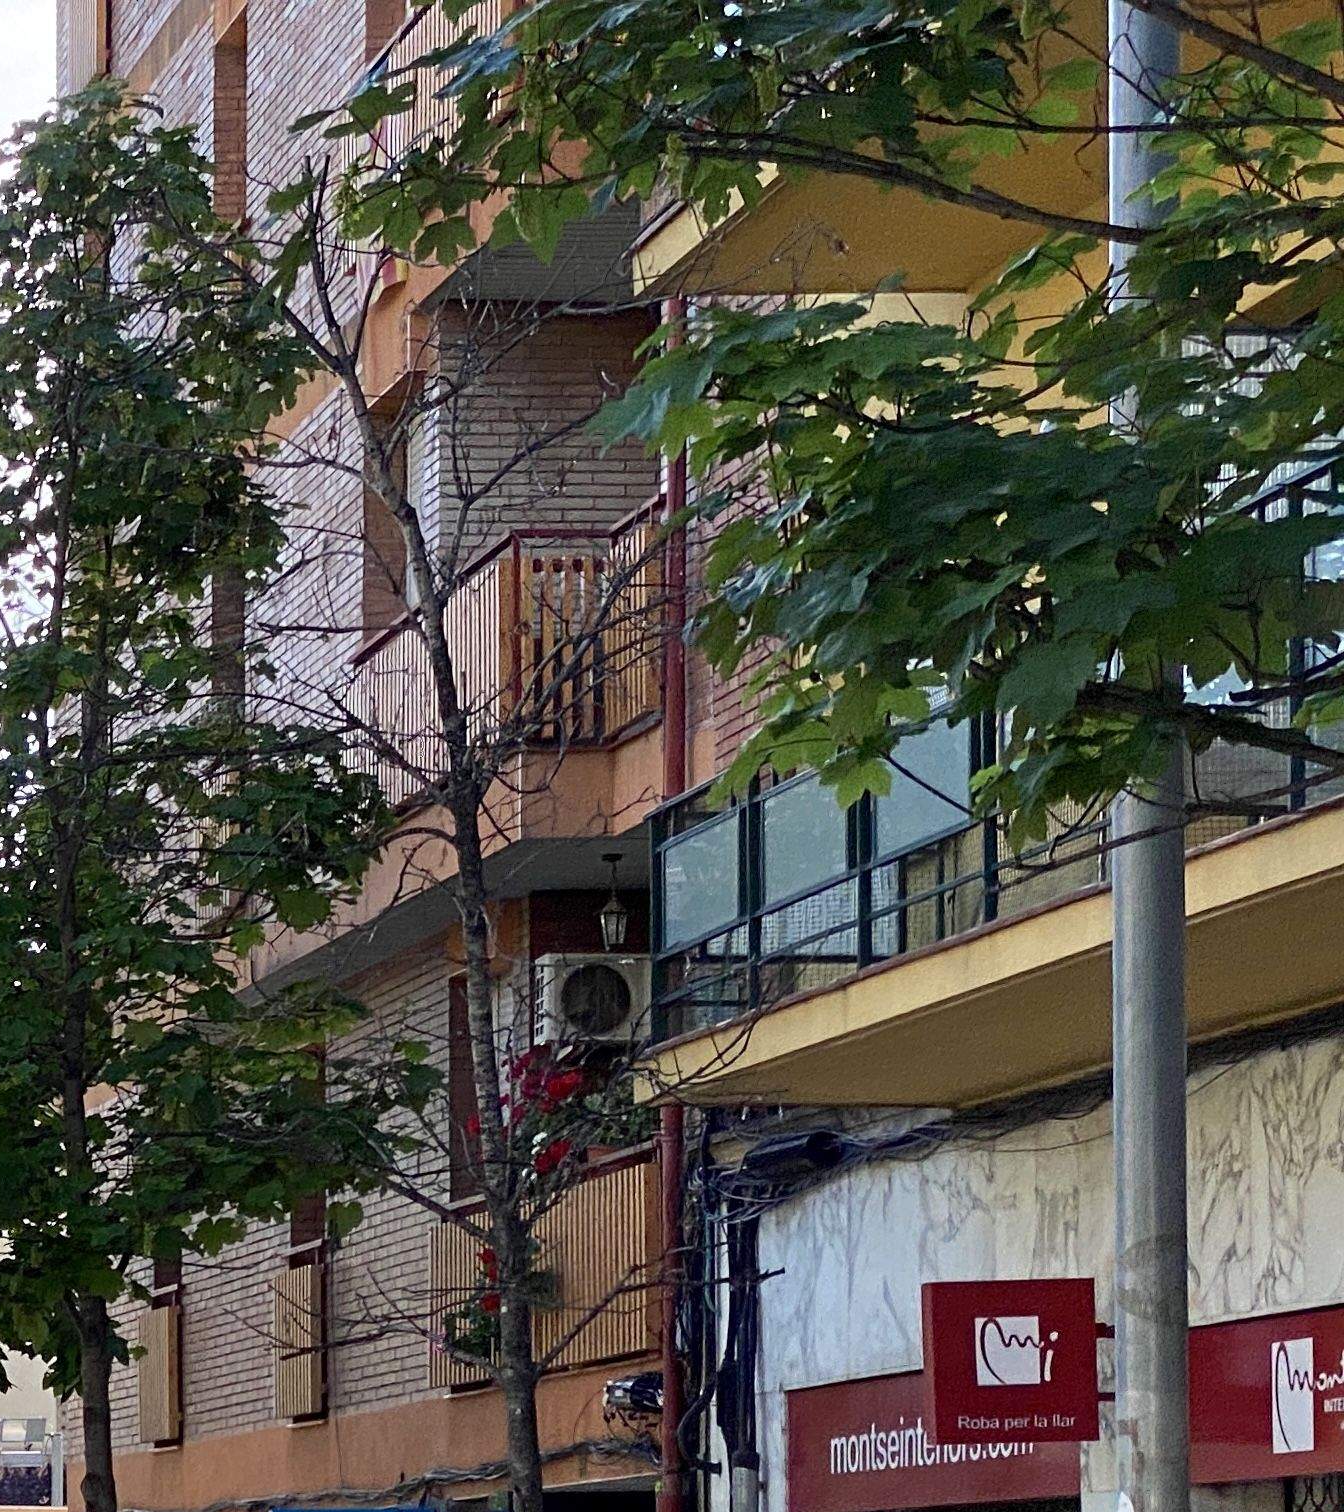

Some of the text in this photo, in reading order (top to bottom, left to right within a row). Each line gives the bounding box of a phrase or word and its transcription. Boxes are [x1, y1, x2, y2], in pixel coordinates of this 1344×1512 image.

[957, 1413, 1075, 1431] Roba per la llar
